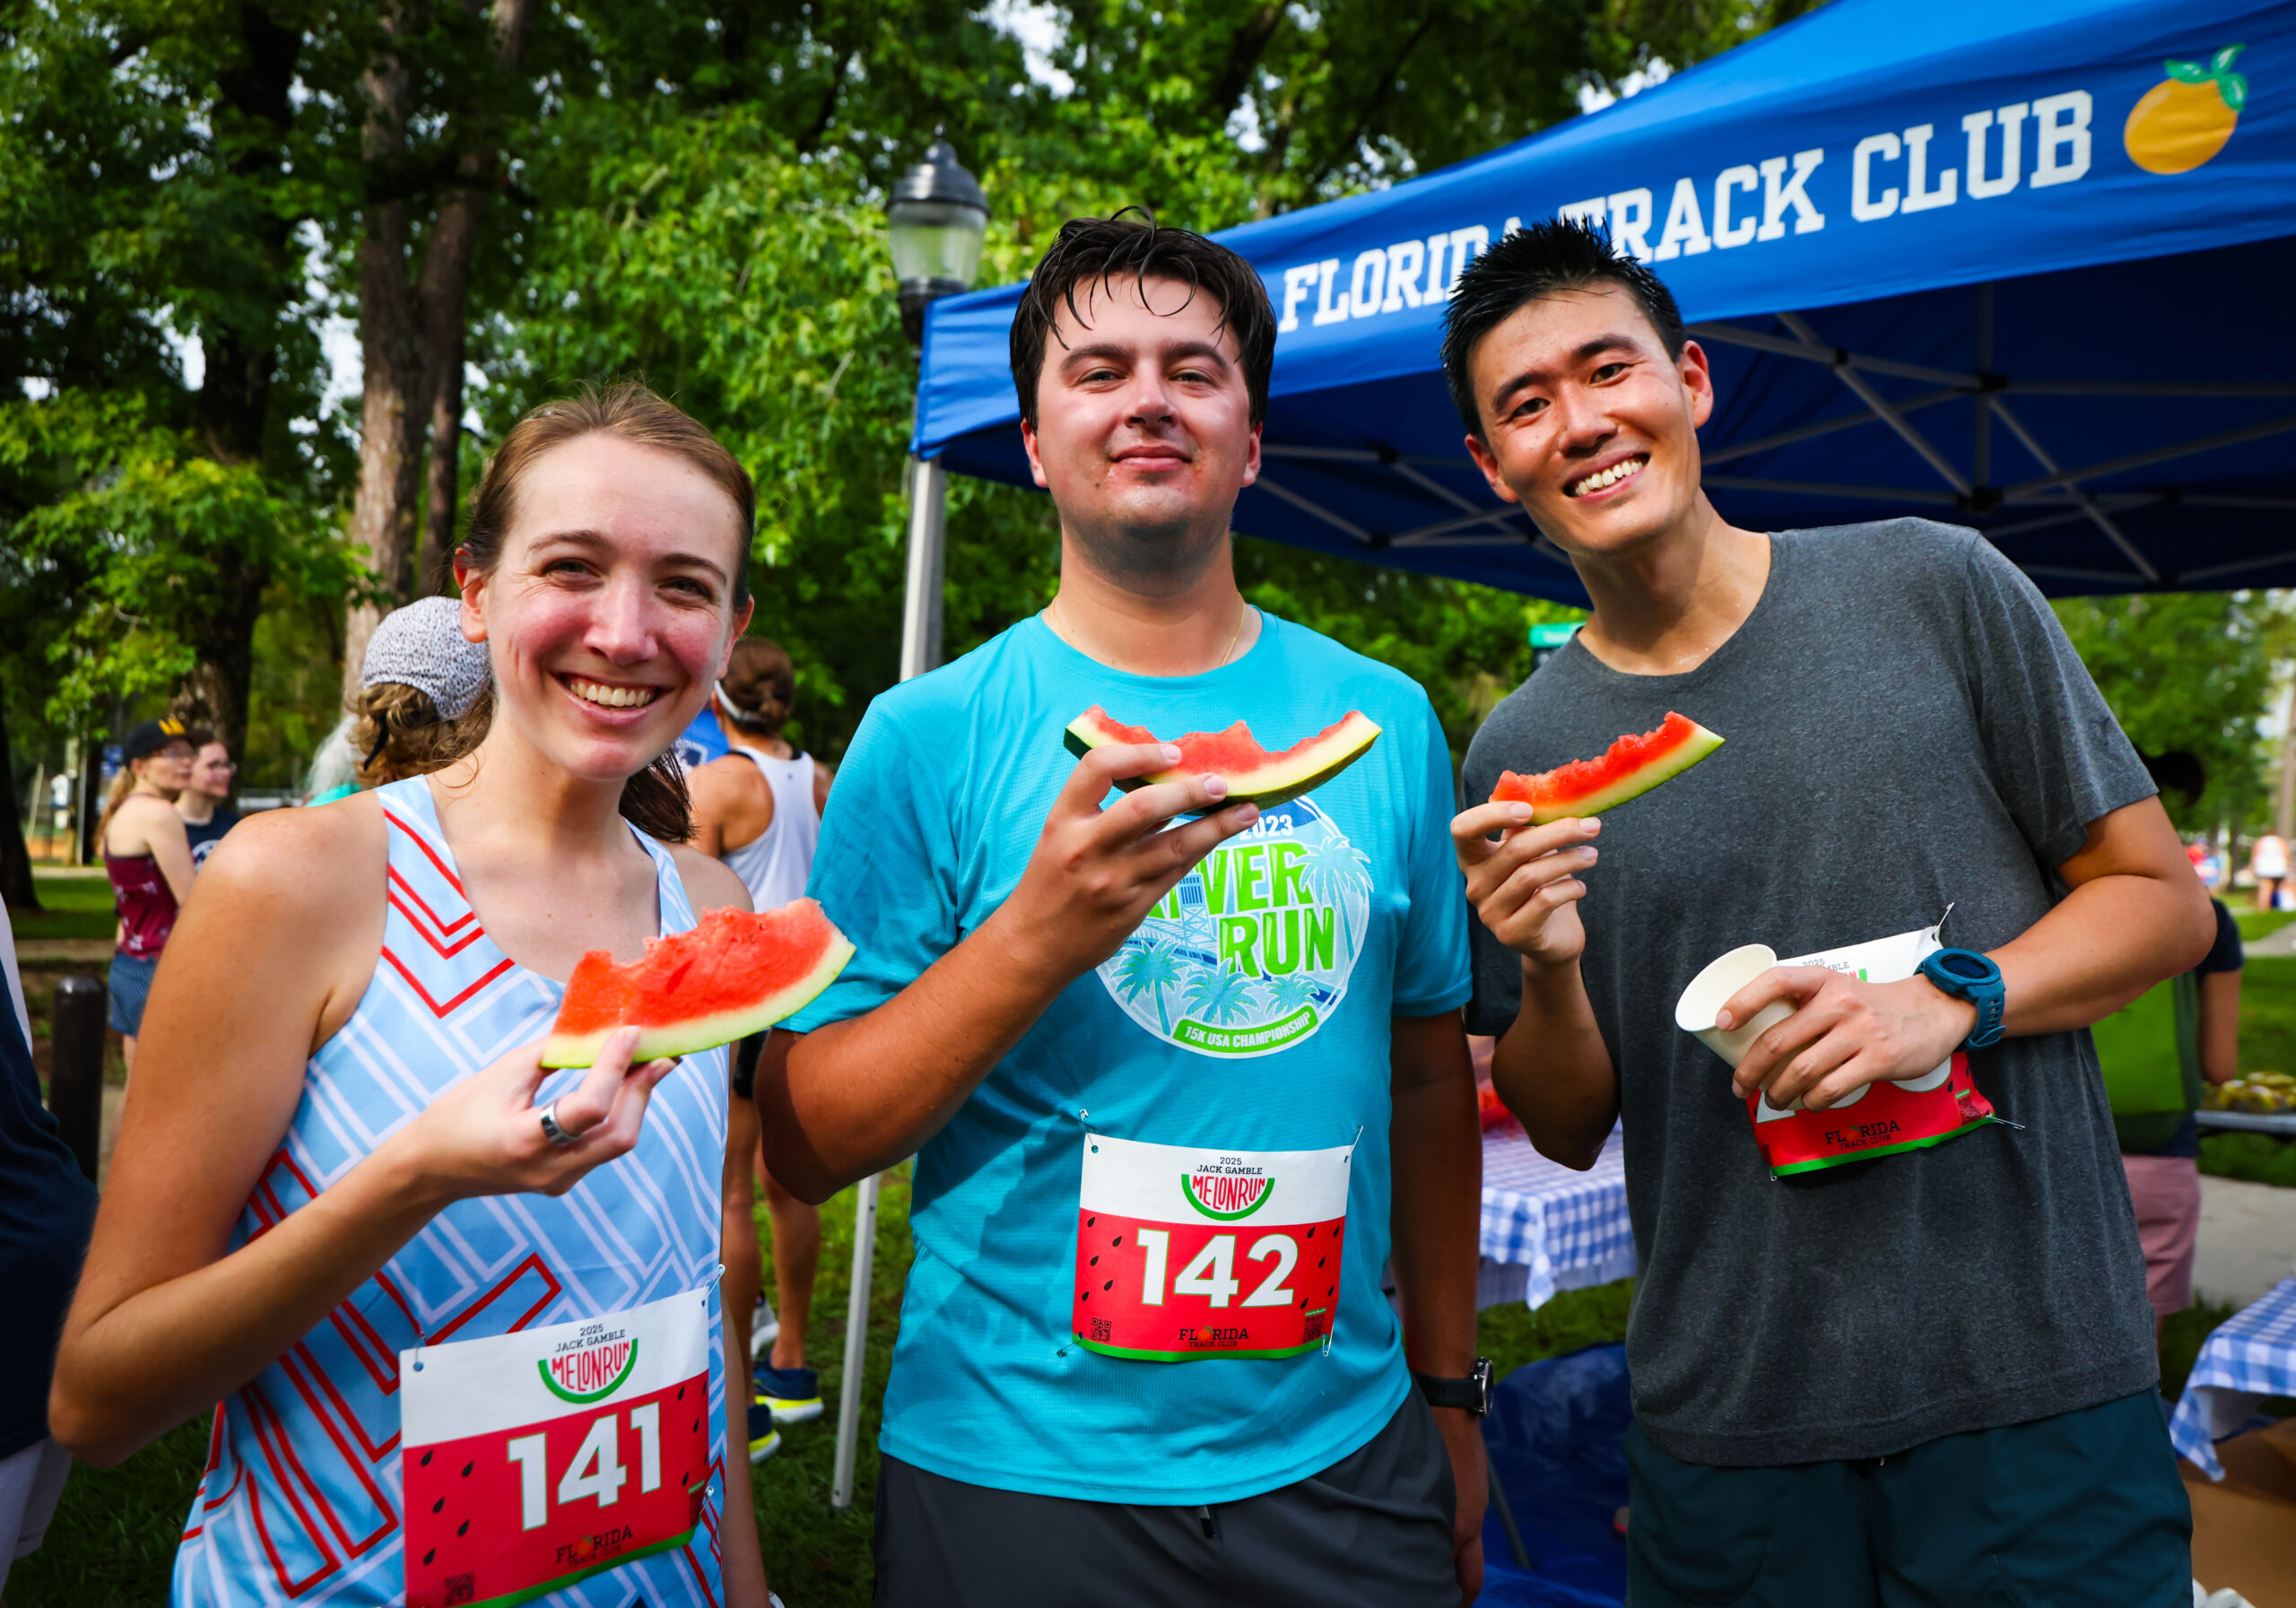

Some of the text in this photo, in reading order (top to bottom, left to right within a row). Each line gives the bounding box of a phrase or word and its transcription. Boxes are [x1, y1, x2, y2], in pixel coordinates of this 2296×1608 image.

[1278, 216, 1523, 334] FLORID
[1850, 89, 2094, 223] CLUB
[1219, 906, 1335, 979] RUN
[1184, 1011, 1311, 1048] 15K USA CHAMPIONSHIP
[1196, 1164, 1263, 1175] JACK GAMBLE
[1220, 1156, 1242, 1166] 2025
[1192, 1175, 1265, 1212] MELONRUN
[1136, 1227, 1299, 1308] 142
[555, 1328, 626, 1352] JACK GAMBLE
[579, 1323, 604, 1336] 2025
[552, 1341, 630, 1392] MELONRUN
[507, 1401, 662, 1532] 141
